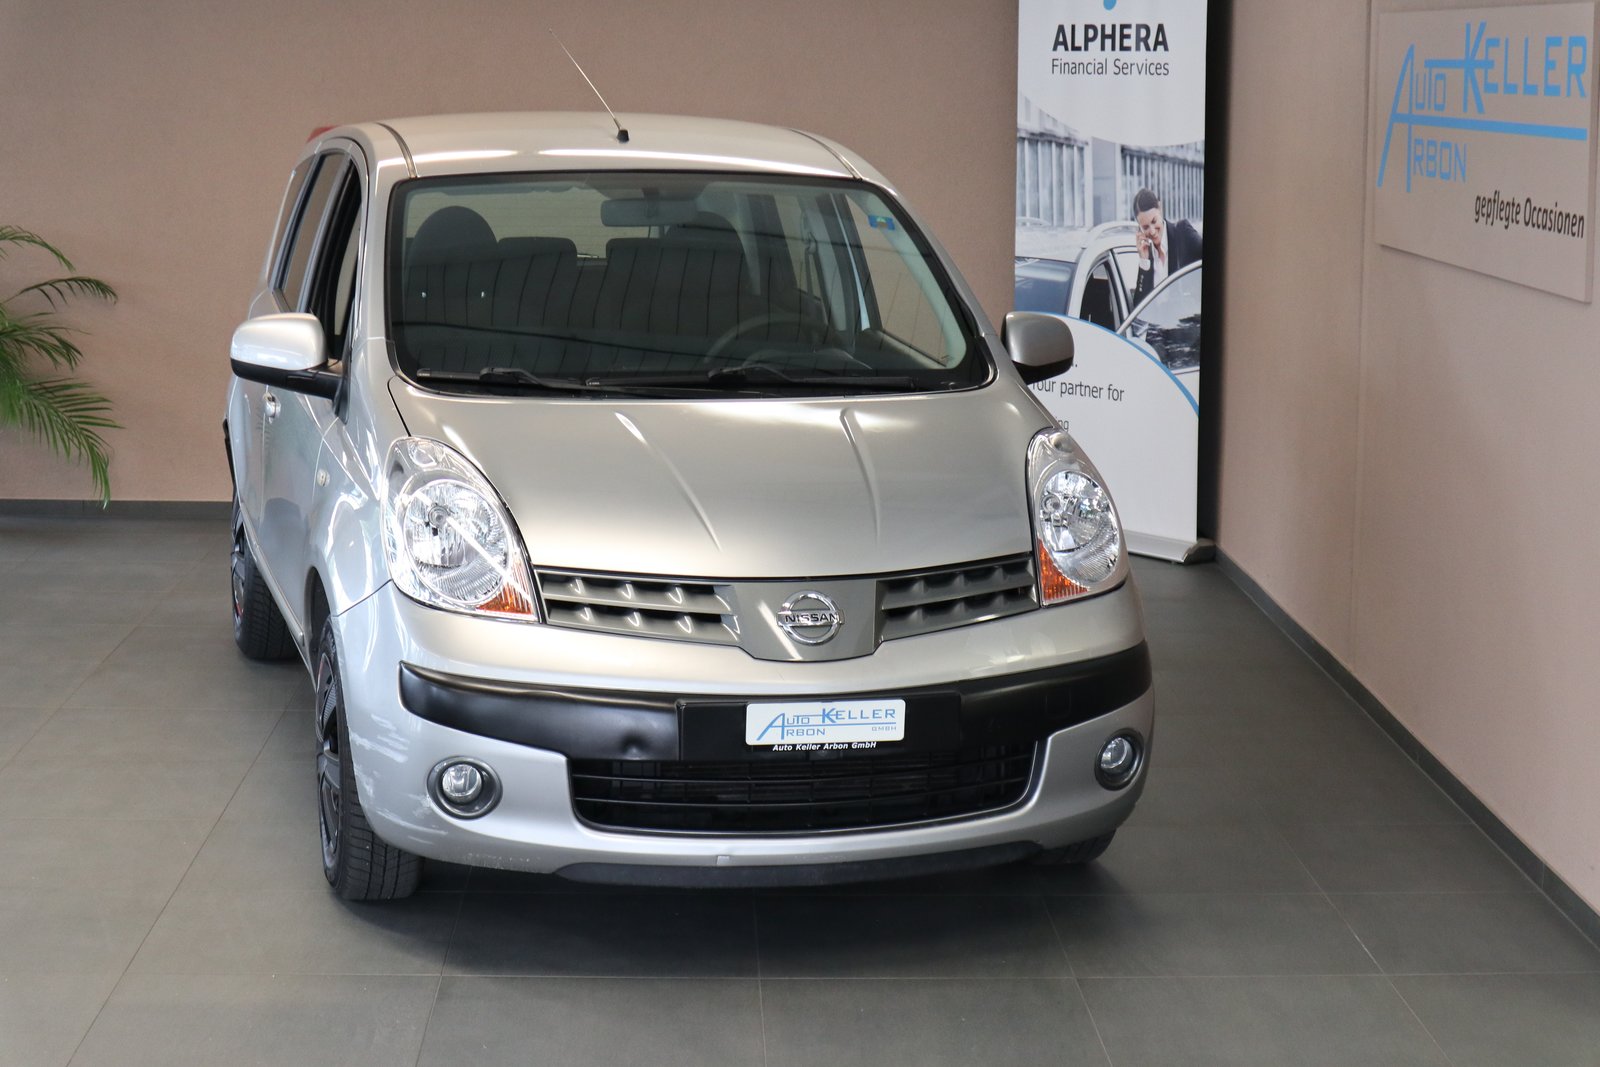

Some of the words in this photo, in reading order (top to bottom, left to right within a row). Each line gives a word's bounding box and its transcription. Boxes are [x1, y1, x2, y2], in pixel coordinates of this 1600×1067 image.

[1052, 23, 1169, 51] ALPHERA
[1051, 58, 1108, 75] Financial
[1113, 58, 1170, 76] Services
[1474, 189, 1521, 230] gepflegte
[1523, 197, 1585, 238] Occasionen
[1060, 379, 1103, 399] partner
[1107, 384, 1125, 402] for
[785, 612, 838, 623] NISSAN
[772, 743, 793, 752] Auto
[795, 743, 821, 751] Keller
[823, 742, 849, 750] Arbon
[851, 741, 877, 749] GmbH
